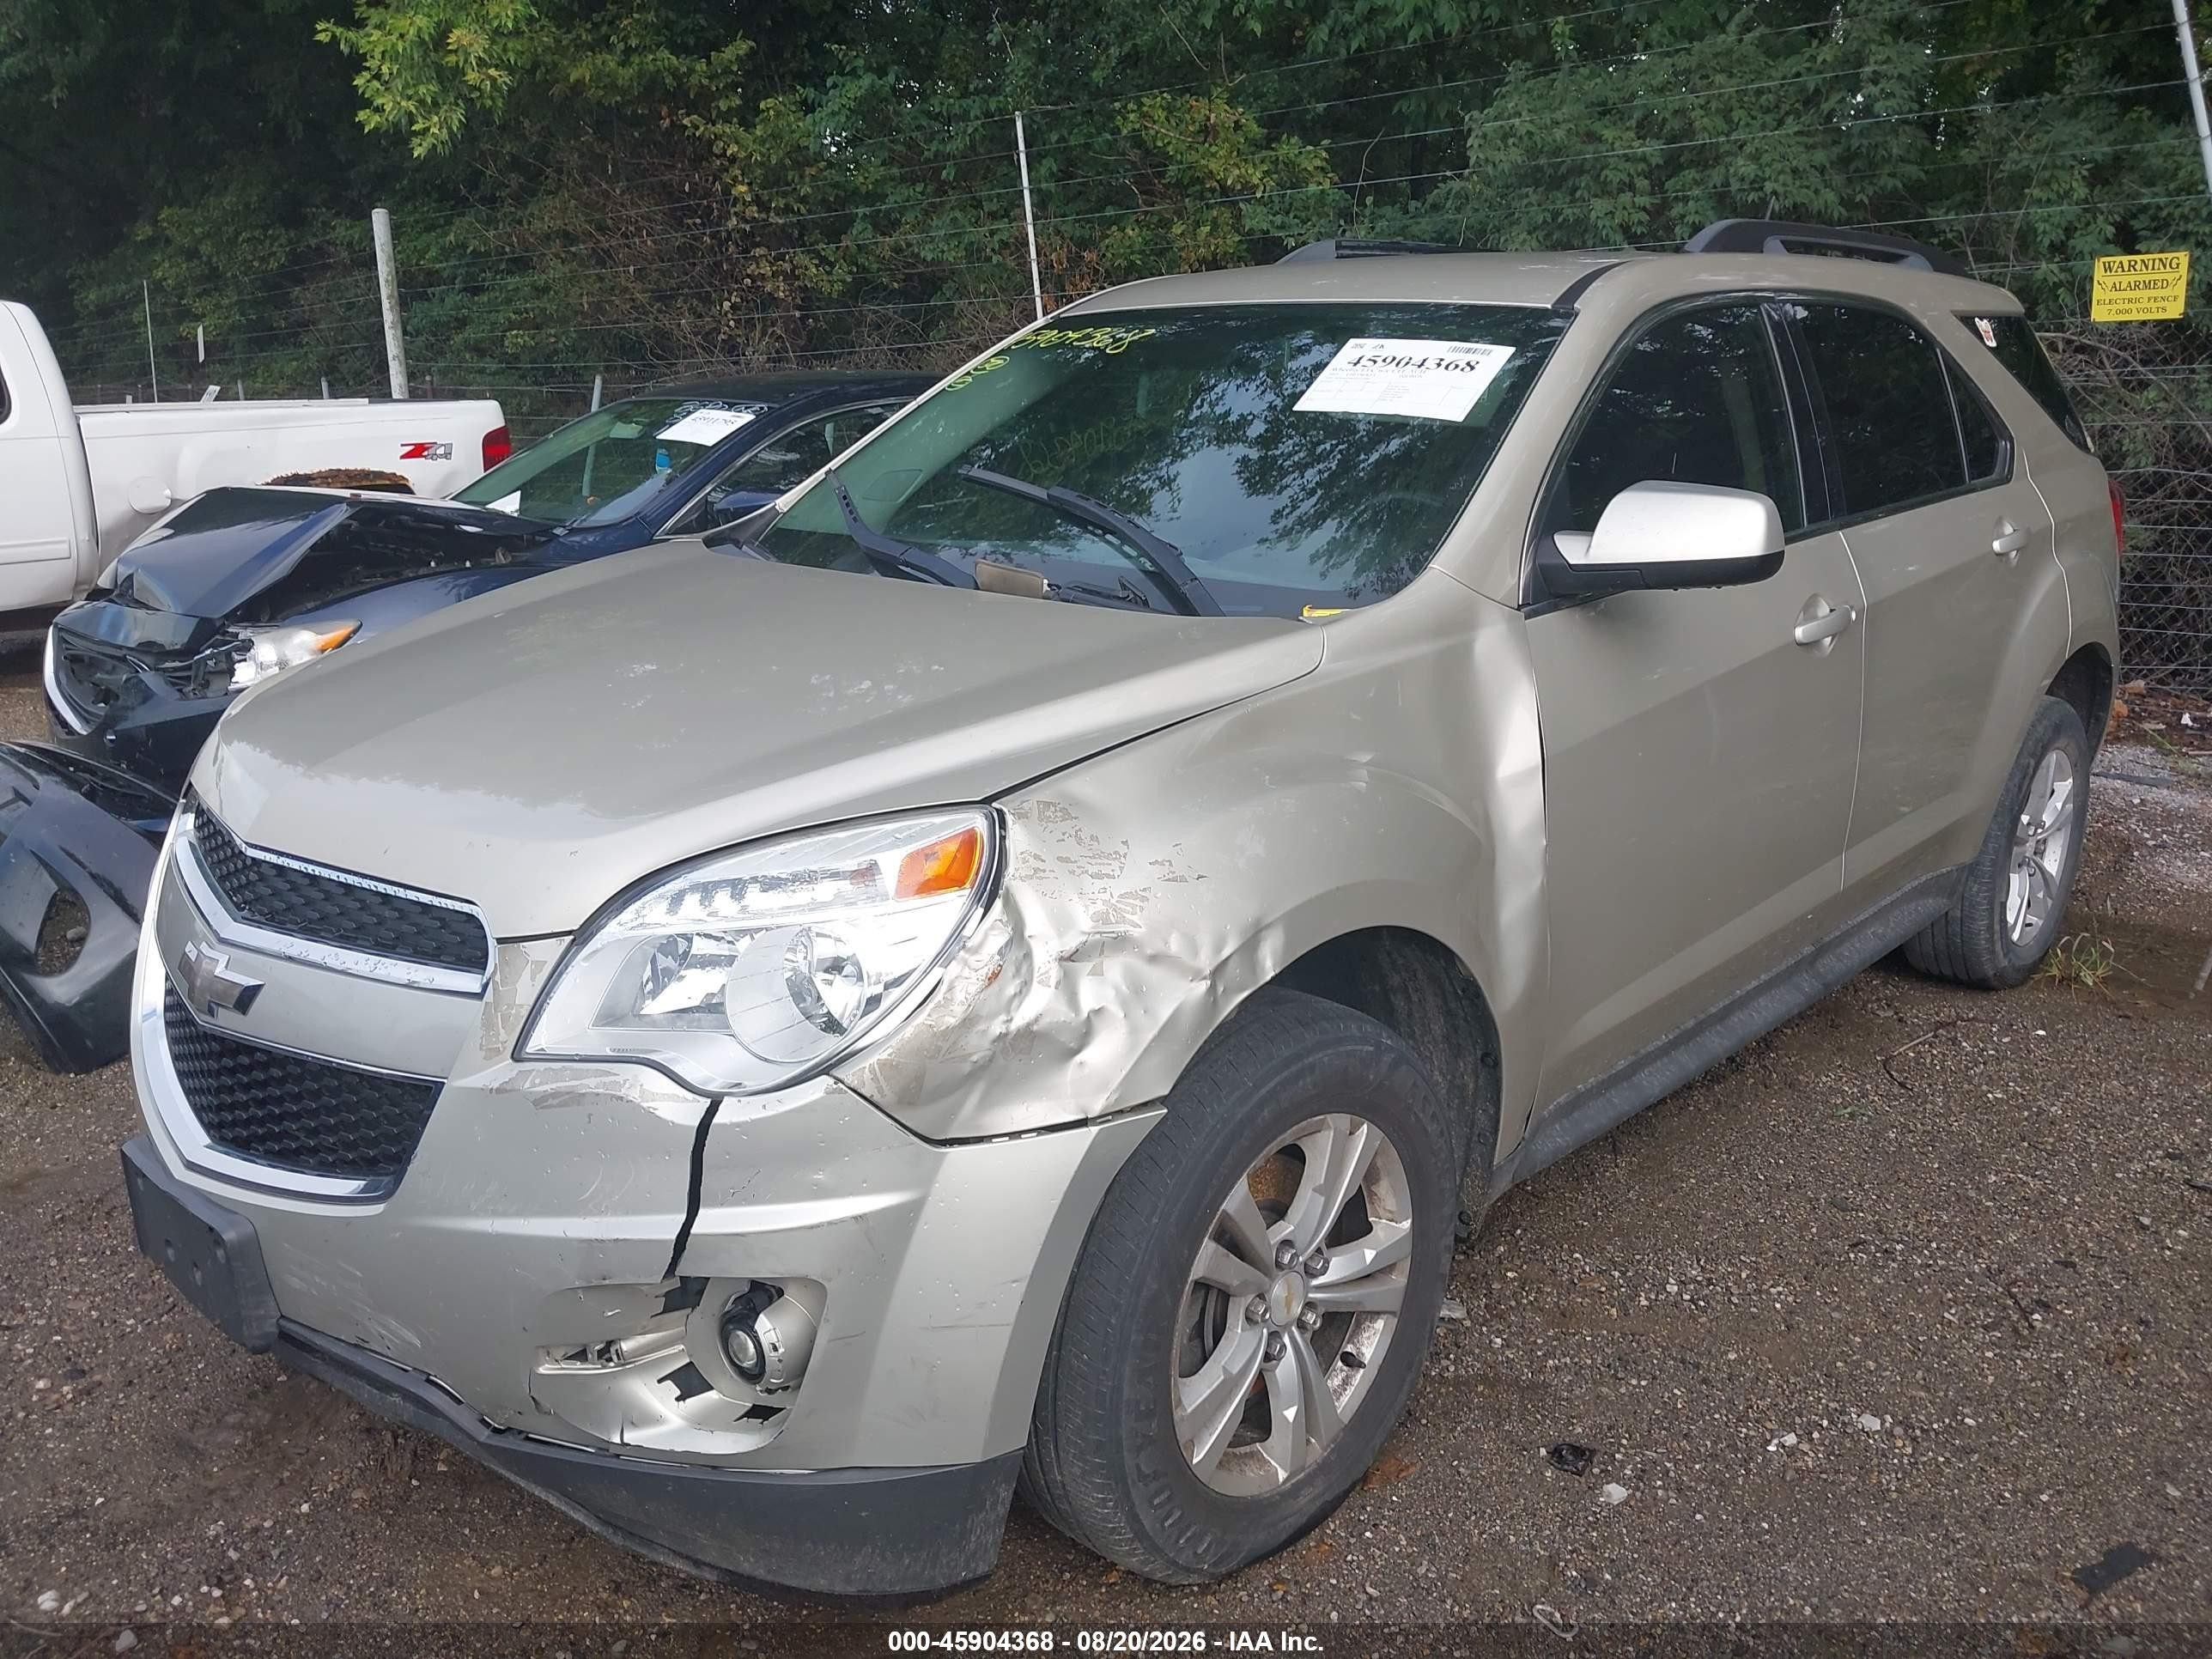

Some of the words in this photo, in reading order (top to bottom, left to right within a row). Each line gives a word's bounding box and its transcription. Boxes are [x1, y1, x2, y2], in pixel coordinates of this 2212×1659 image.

[2102, 257, 2180, 274] WARNING
[2109, 278, 2169, 292] ALARMED
[2096, 297, 2144, 306] ELECTRIC
[2136, 306, 2167, 314] VOLTS
[1347, 355, 1480, 374] 45904368
